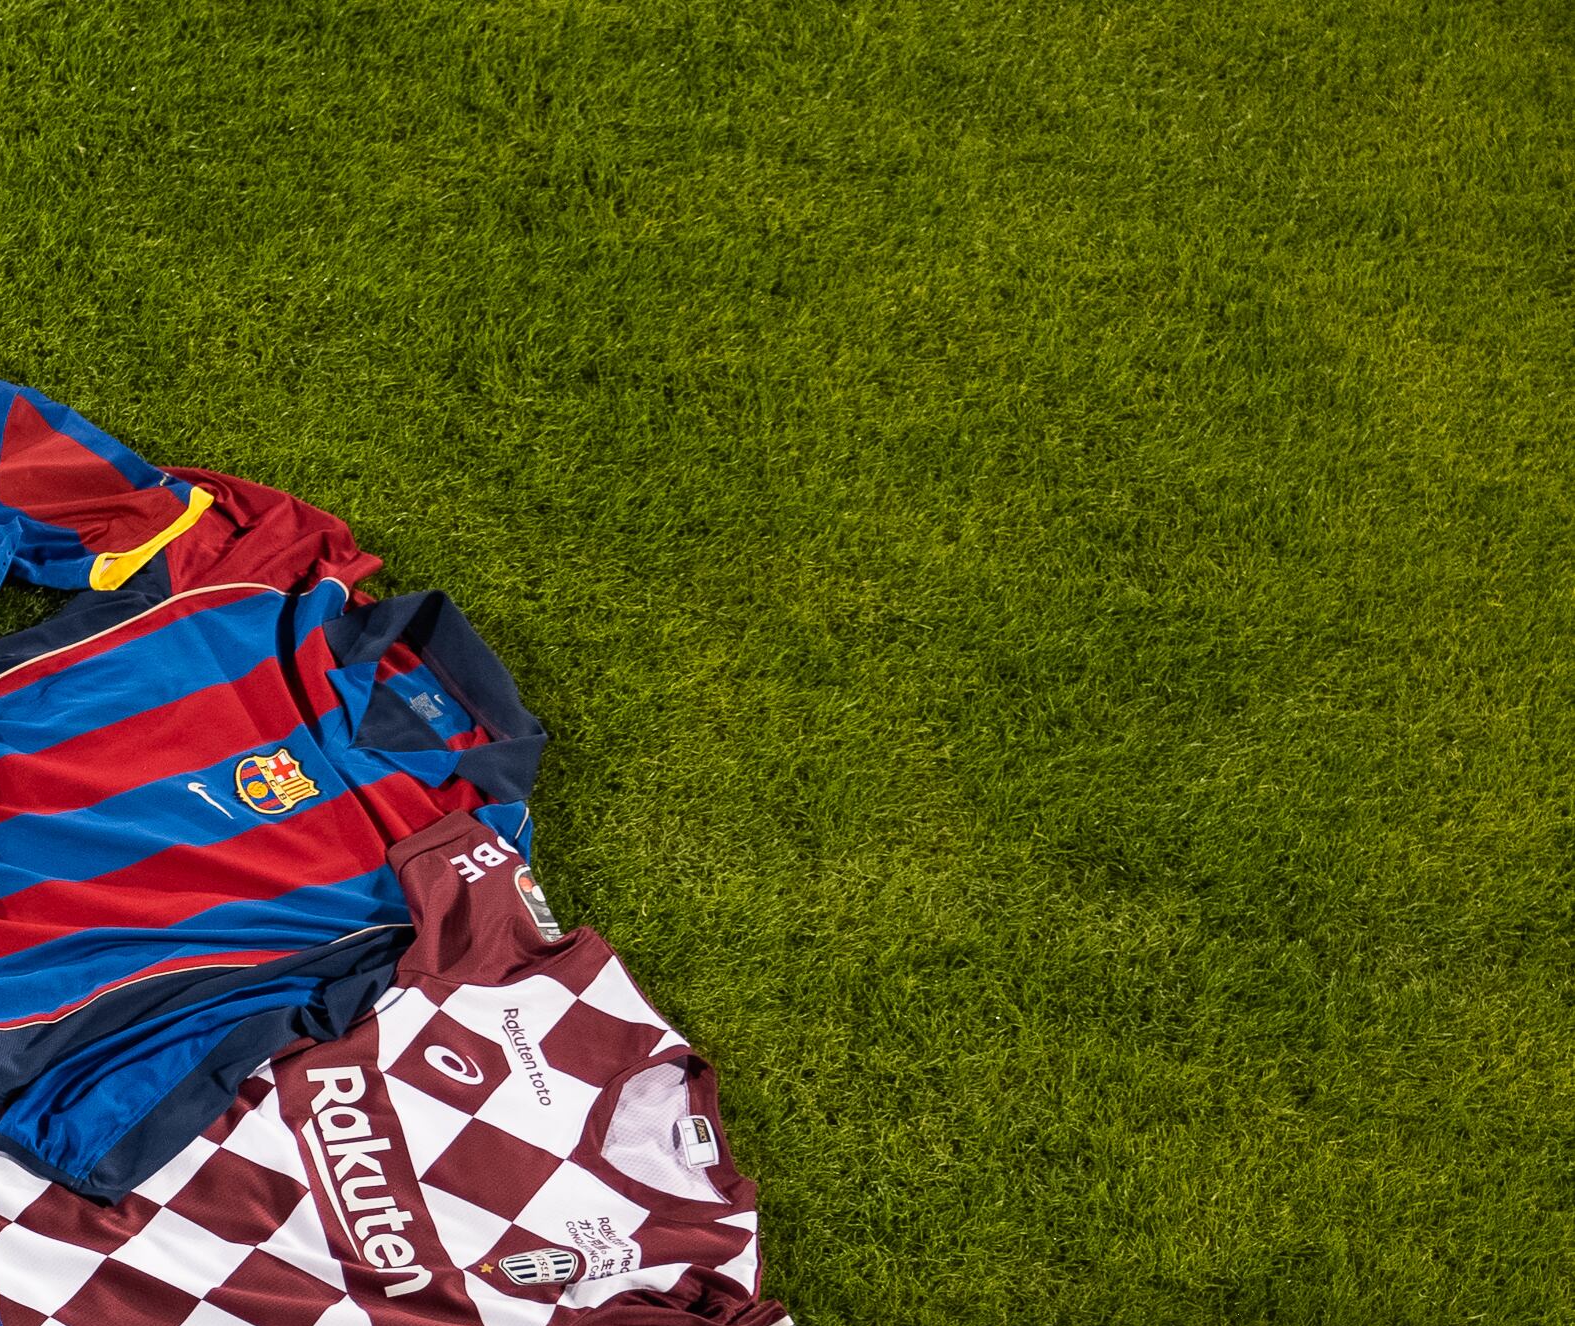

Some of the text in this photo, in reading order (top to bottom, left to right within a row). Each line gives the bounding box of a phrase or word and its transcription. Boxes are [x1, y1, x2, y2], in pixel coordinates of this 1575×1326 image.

[502, 1008, 552, 1106] Rakuten toto
[302, 1065, 433, 1298] Rakuten
